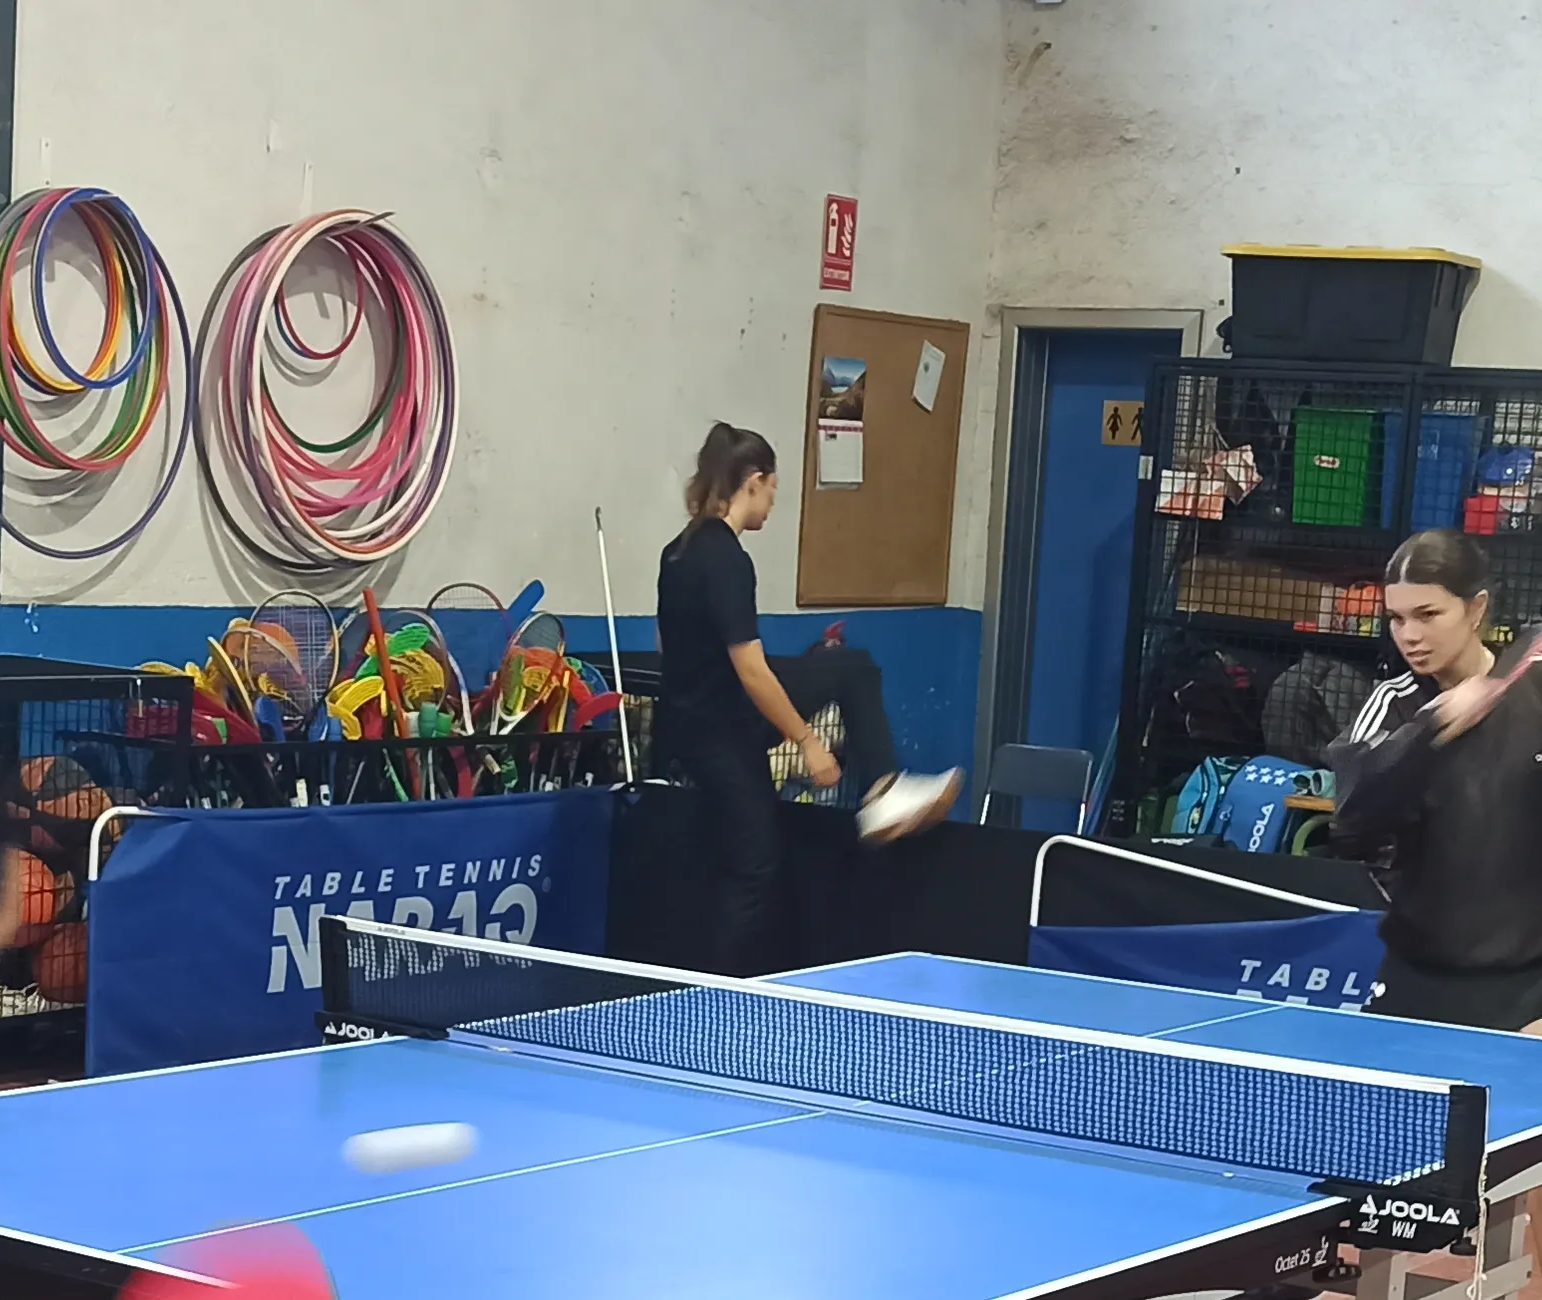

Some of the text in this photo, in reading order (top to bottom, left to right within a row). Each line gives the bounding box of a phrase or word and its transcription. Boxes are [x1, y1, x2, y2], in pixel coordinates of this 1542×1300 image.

[274, 854, 543, 900] TABLE TENNIS
[1239, 959, 1373, 1003] TABL
[1379, 1198, 1460, 1226] JOOLA
[1391, 1220, 1417, 1239] WM
